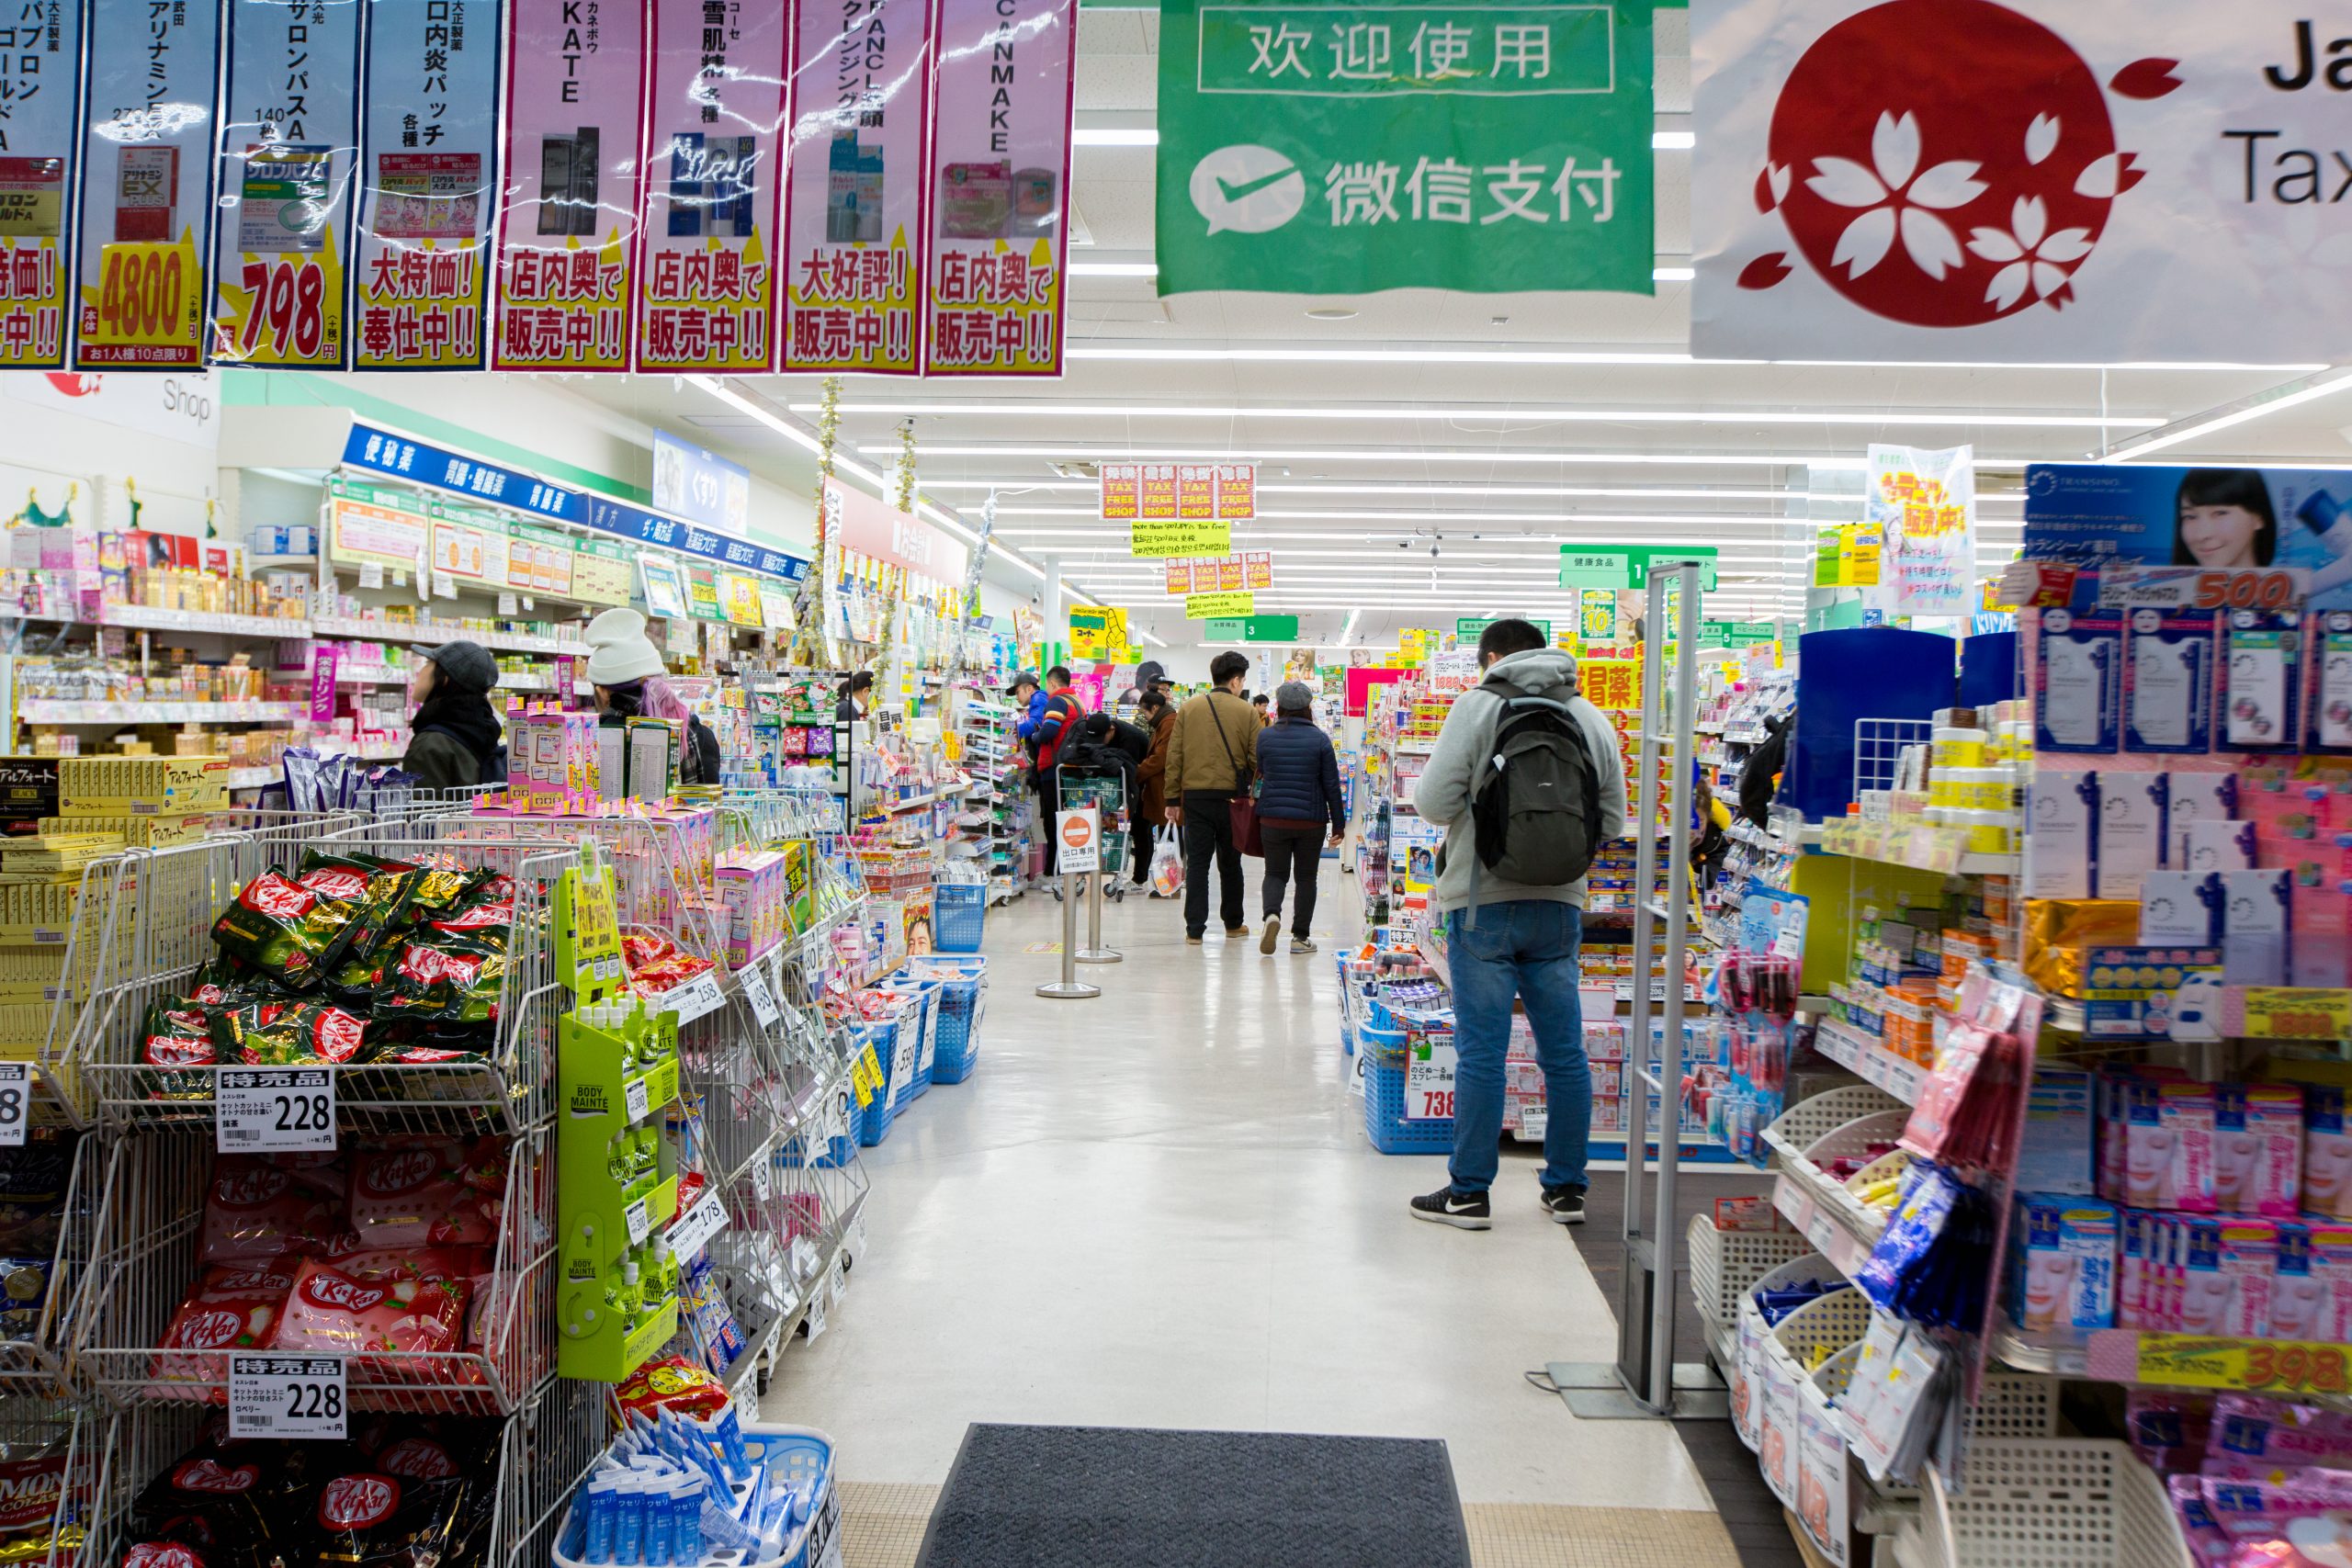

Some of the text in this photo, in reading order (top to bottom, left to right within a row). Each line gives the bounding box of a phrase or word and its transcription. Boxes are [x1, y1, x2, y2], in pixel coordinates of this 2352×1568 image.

[47, 0, 60, 52] 大正製薬
[173, 0, 185, 26] 武田
[450, 0, 464, 51] 大正製薬
[586, 1, 598, 53] カネボウ
[701, 1, 727, 78] 雪肌精
[18, 2, 43, 101] パブロン
[561, 1, 582, 103] KATE
[1247, 21, 1551, 80] 欢迎使用
[286, 1, 310, 141] サロンパスA
[423, 1, 447, 147] 口内炎パッチ
[990, 0, 1016, 152] CANMAKE
[254, 108, 285, 122] 140
[401, 114, 419, 148] 各種
[123, 169, 163, 182] アリナミン
[122, 181, 162, 197] EX
[129, 194, 165, 207] PLUS
[1325, 155, 1622, 227] 微信支付
[370, 247, 472, 298] 大特価!
[510, 249, 622, 299] 店内奥で
[652, 249, 765, 300] 店内奥で
[800, 248, 904, 299] 大好評!
[938, 250, 1050, 301] 店内奥で
[101, 251, 182, 337] 4800
[243, 262, 323, 356] 798
[0, 307, 57, 357] 中!!
[365, 306, 475, 358] 奉仕中!!
[505, 308, 620, 359] 販売中!!
[648, 308, 763, 359] 販売中!!
[794, 308, 909, 359] 販売中!!
[935, 310, 1050, 361] 販売中!!
[90, 345, 188, 361] お1人様10点限り
[322, 344, 336, 358] 円
[164, 378, 210, 426] Shop
[364, 434, 416, 472] 便秘薬
[691, 469, 719, 510] くすり
[1105, 495, 1136, 504] FREE
[1109, 483, 1133, 491] TAX
[1145, 494, 1174, 503] FREE
[1147, 482, 1171, 491] TAX
[1182, 482, 1208, 491] TAX
[1182, 495, 1211, 504] FREE
[1221, 494, 1250, 503] FREE
[1223, 482, 1248, 491] TAX
[1105, 506, 1137, 516] SHOP
[1144, 506, 1175, 516] SHOP
[1181, 507, 1212, 516] SHOP
[1220, 506, 1252, 516] SHOP
[1211, 522, 1227, 530] free
[1574, 558, 1614, 567] 健康食品
[1634, 563, 1642, 580] 1
[2196, 570, 2292, 610] 500
[1248, 626, 1255, 635] 3
[1586, 610, 1609, 632] 10
[1723, 633, 1731, 643] 5
[312, 655, 337, 714] 栄養ドリンク
[1434, 675, 1459, 689] 1080
[169, 770, 205, 785] アルフォート
[12, 789, 38, 798] BLACK
[153, 824, 185, 843] アルフォート
[1062, 846, 1095, 858] 出口専用
[698, 983, 717, 1003] 158
[223, 1071, 327, 1088] 特売品
[577, 1086, 604, 1098] BODY
[275, 1095, 330, 1131] 228
[571, 1097, 609, 1109] MAINTÉ
[1423, 1090, 1454, 1117] 738
[377, 1151, 435, 1190] KitKat
[700, 1201, 720, 1227] 178
[568, 1267, 596, 1277] MAINTÉ
[572, 1259, 592, 1268] BODY
[313, 1279, 383, 1310] KitKat
[183, 1312, 241, 1348] KitKat
[236, 1359, 337, 1374] 特売品
[2243, 1344, 2346, 1385] 398
[287, 1383, 342, 1419] 228
[333, 1481, 392, 1522] KitKat
[673, 1500, 701, 1512] ワセリン
